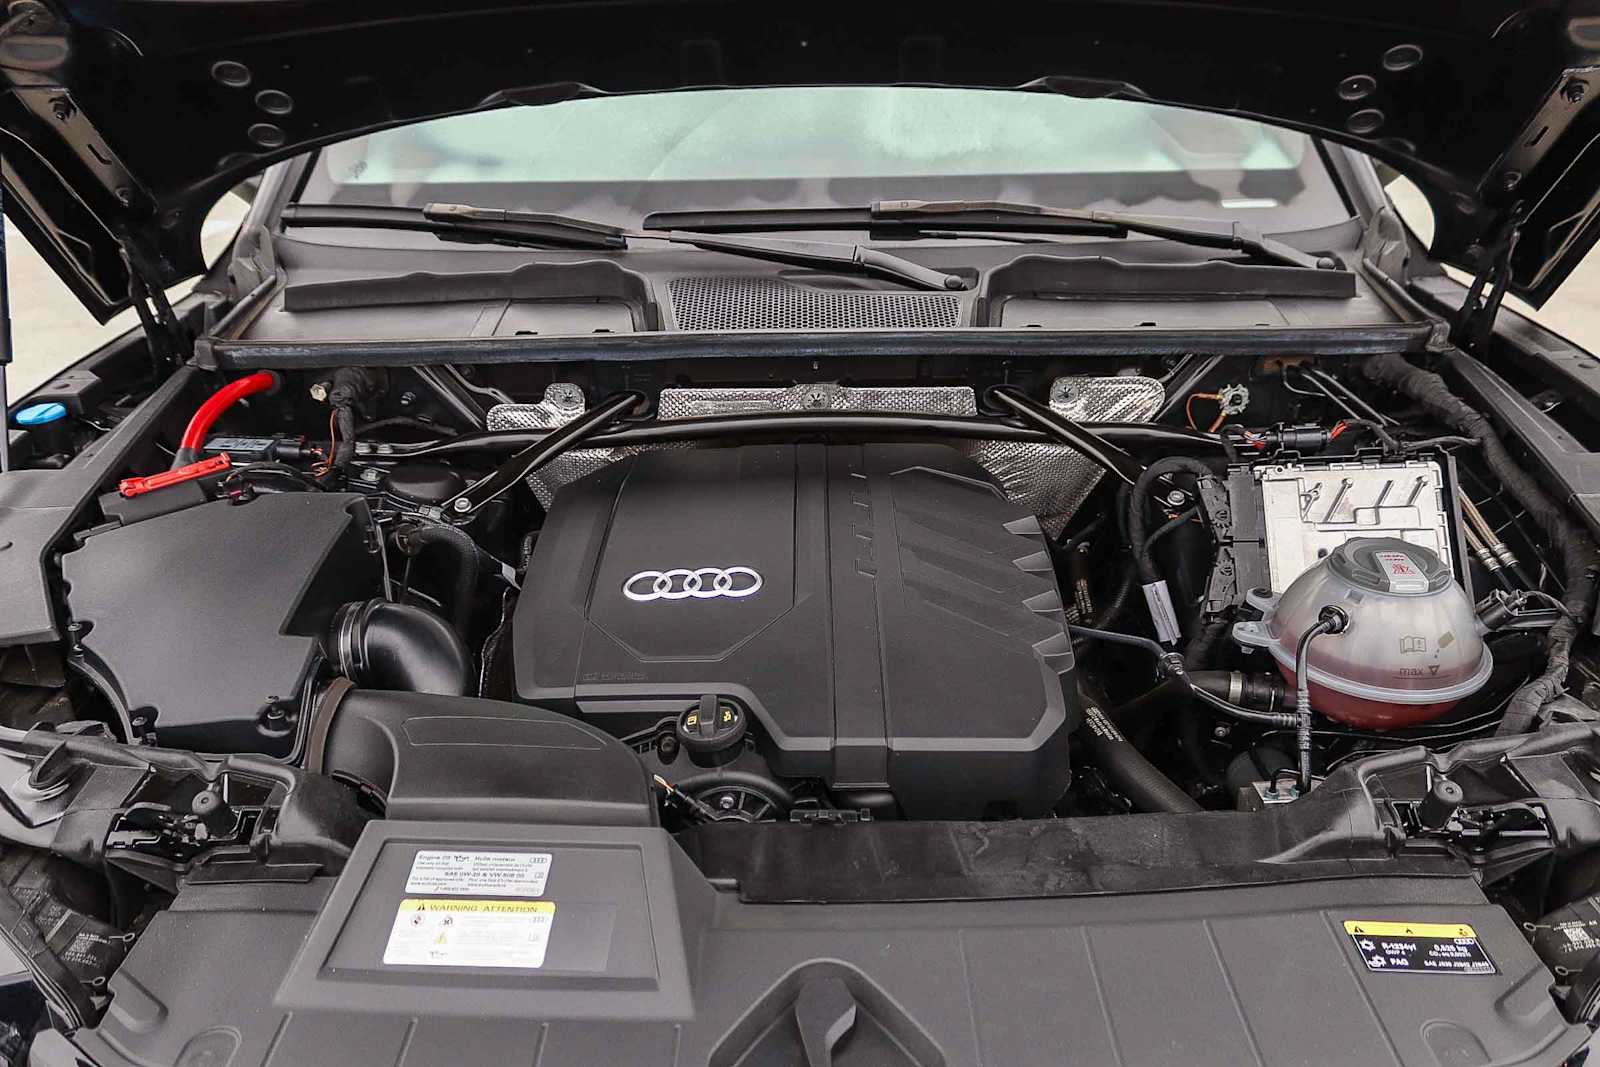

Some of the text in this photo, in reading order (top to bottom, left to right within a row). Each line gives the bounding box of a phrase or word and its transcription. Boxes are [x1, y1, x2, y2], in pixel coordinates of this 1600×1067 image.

[1399, 667, 1424, 676] max
[430, 904, 538, 913] WARNING ATTENTION
[1381, 942, 1417, 951] R-1234yf
[1456, 945, 1468, 954] kg
